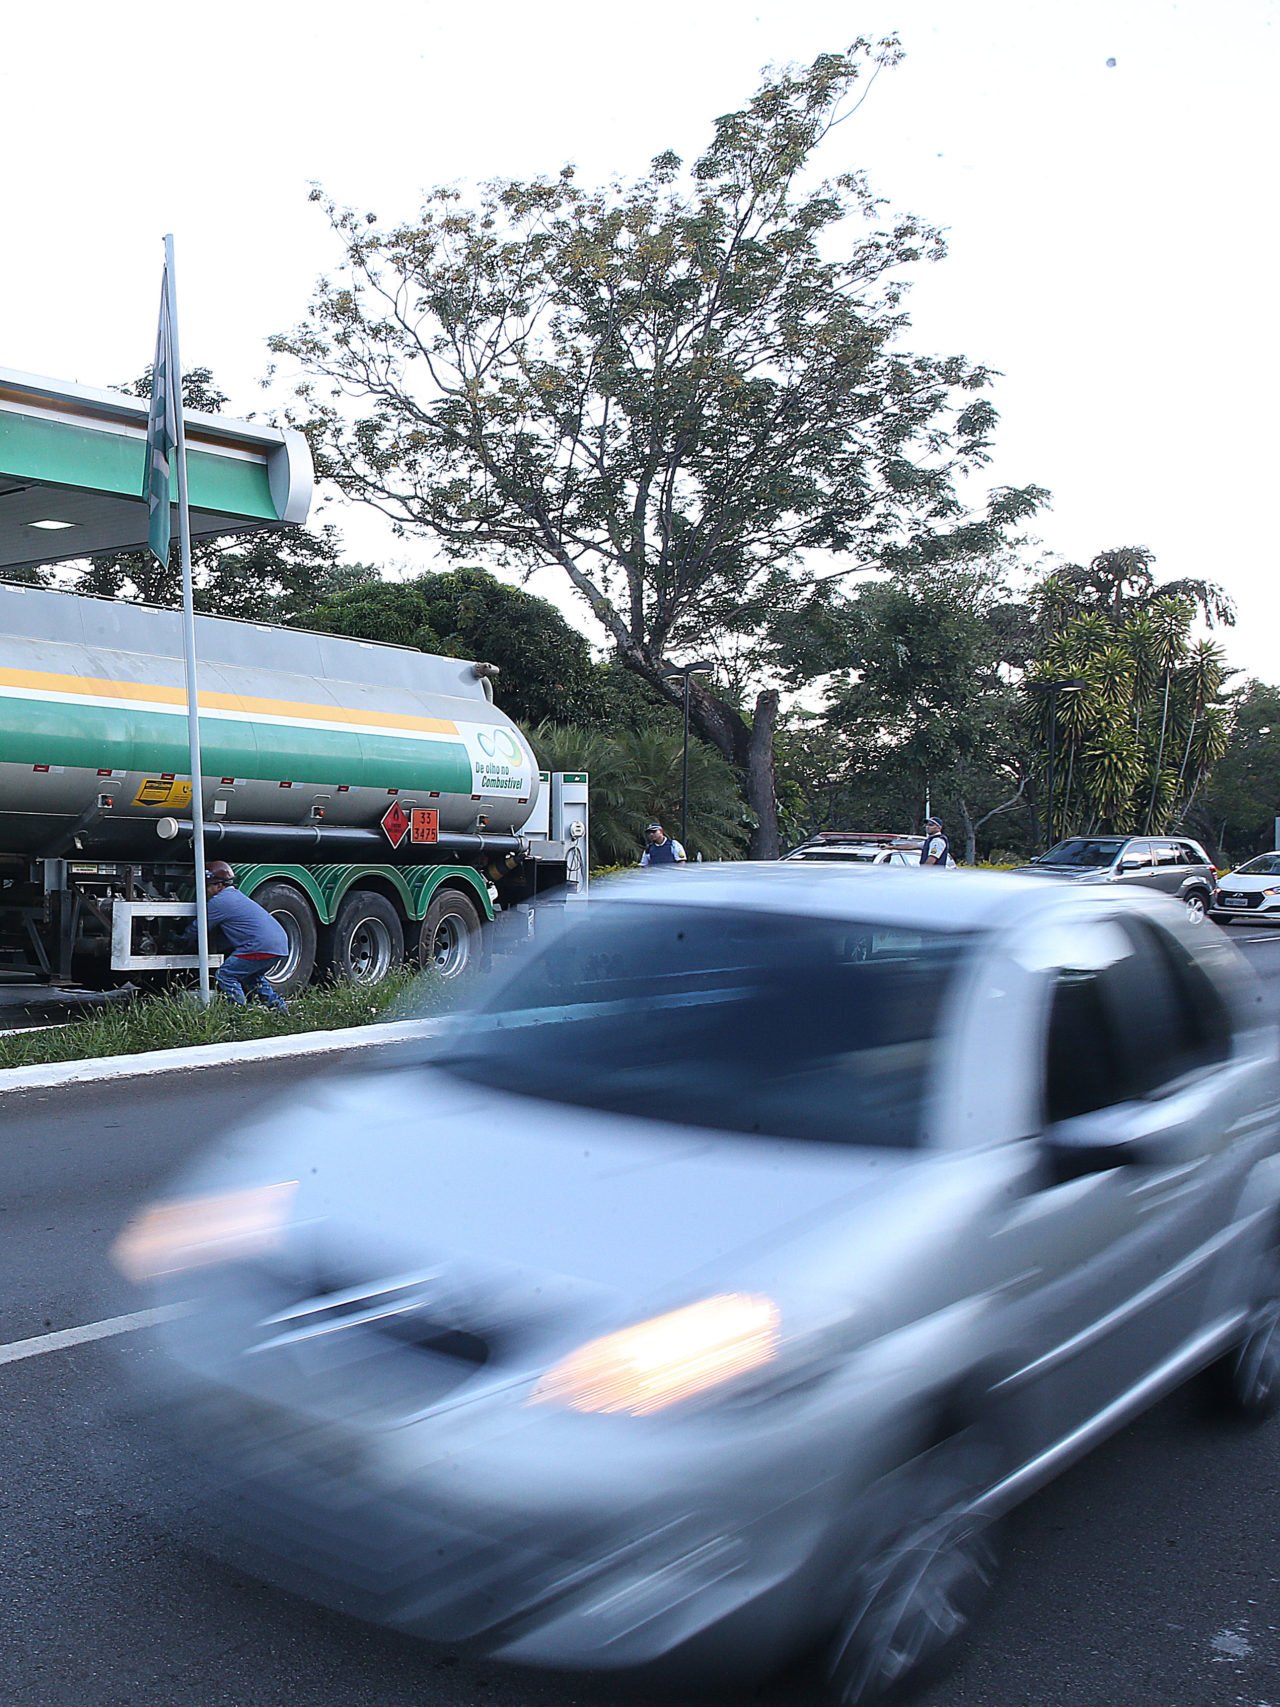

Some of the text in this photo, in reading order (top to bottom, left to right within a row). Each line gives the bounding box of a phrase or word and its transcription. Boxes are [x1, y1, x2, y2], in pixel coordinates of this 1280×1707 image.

[475, 761, 510, 776] De olho no
[420, 812, 431, 824] 33
[414, 827, 436, 840] 3475
